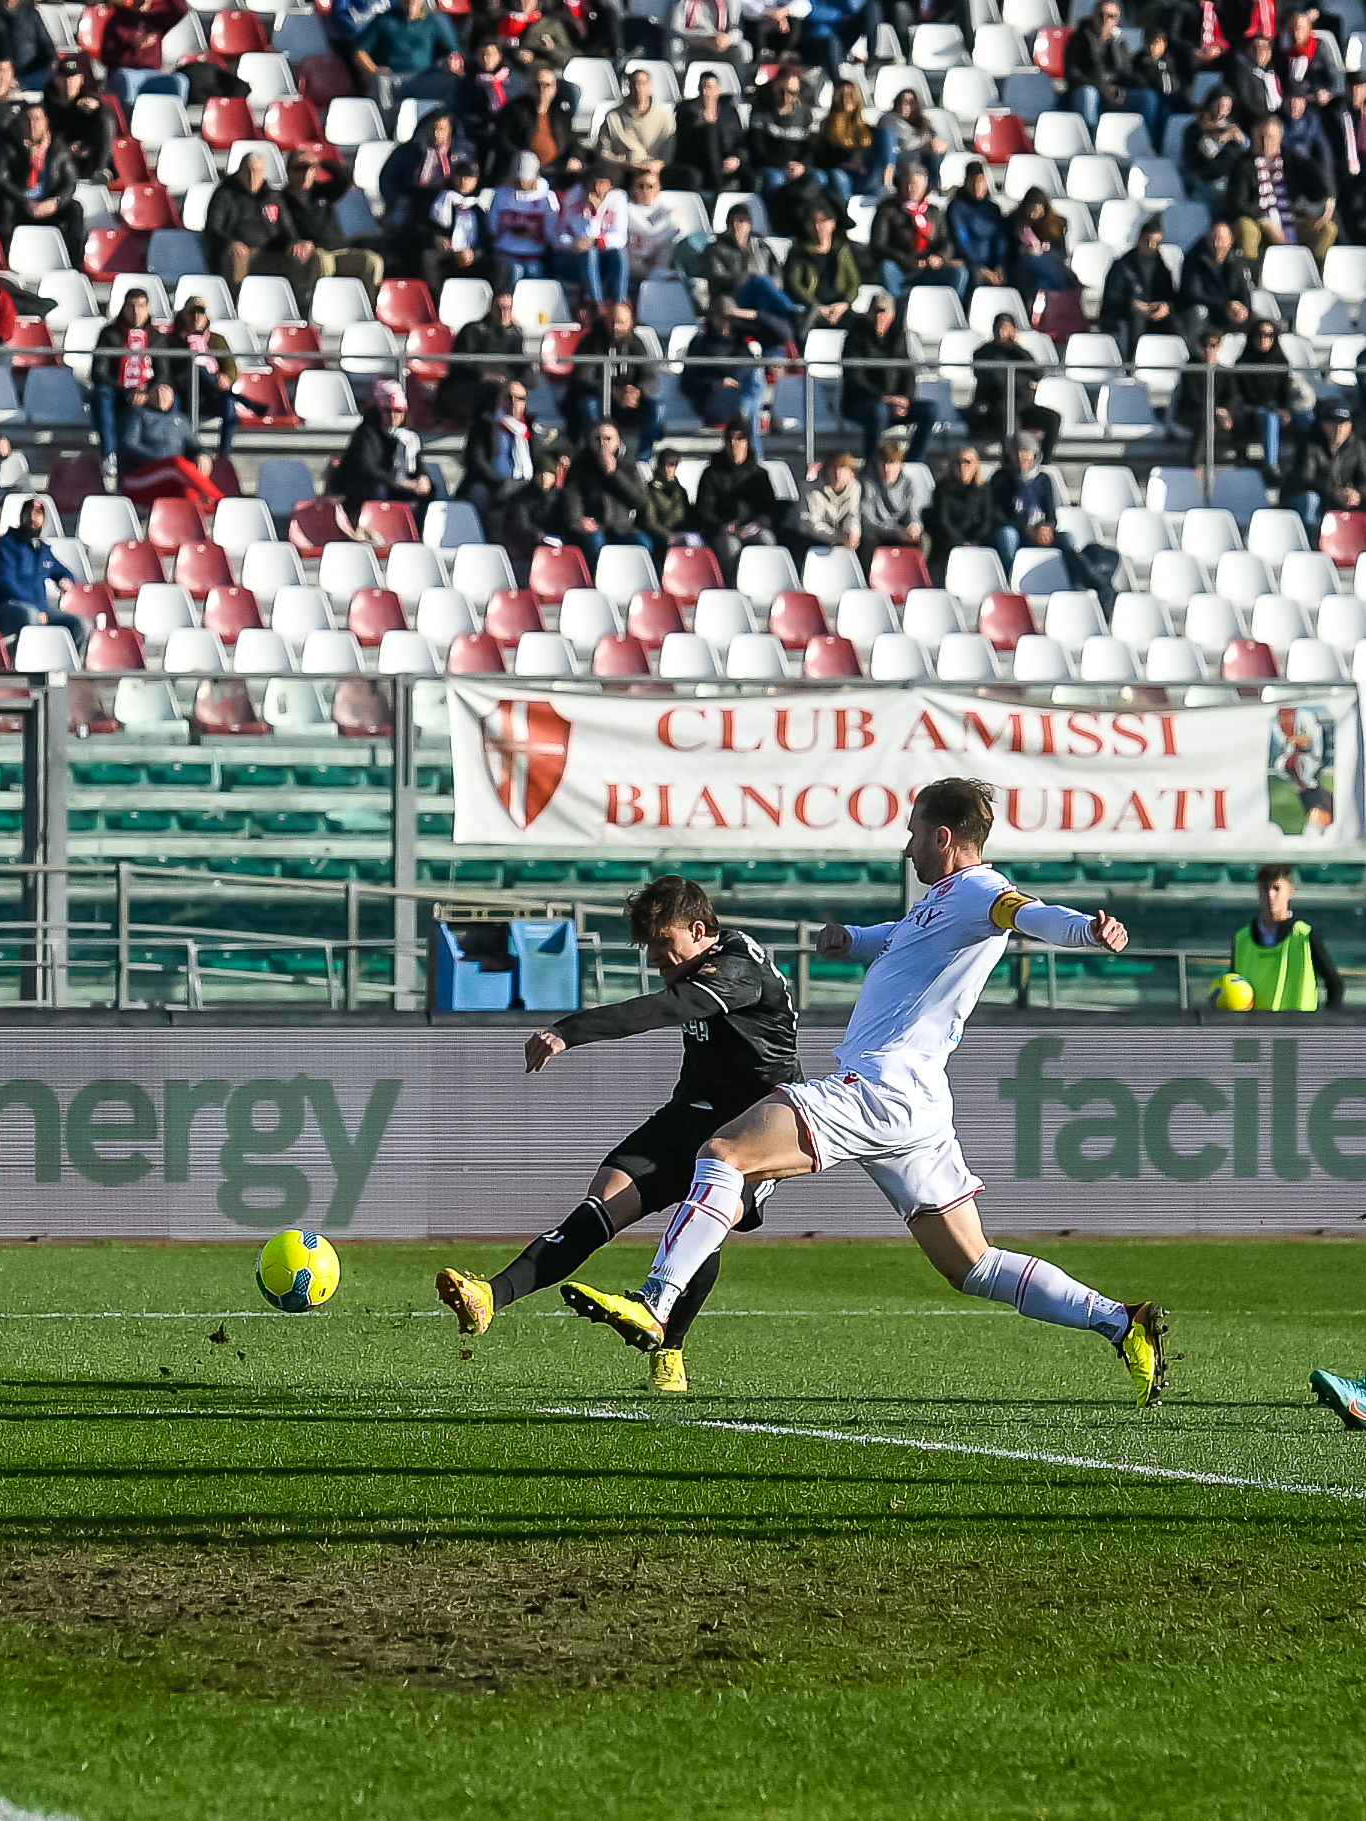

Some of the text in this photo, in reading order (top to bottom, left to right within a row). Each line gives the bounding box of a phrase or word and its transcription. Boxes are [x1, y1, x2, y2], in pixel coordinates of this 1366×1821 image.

[656, 705, 1181, 757] CLUB AMISSI
[605, 782, 1230, 832] BIANCOUDATI
